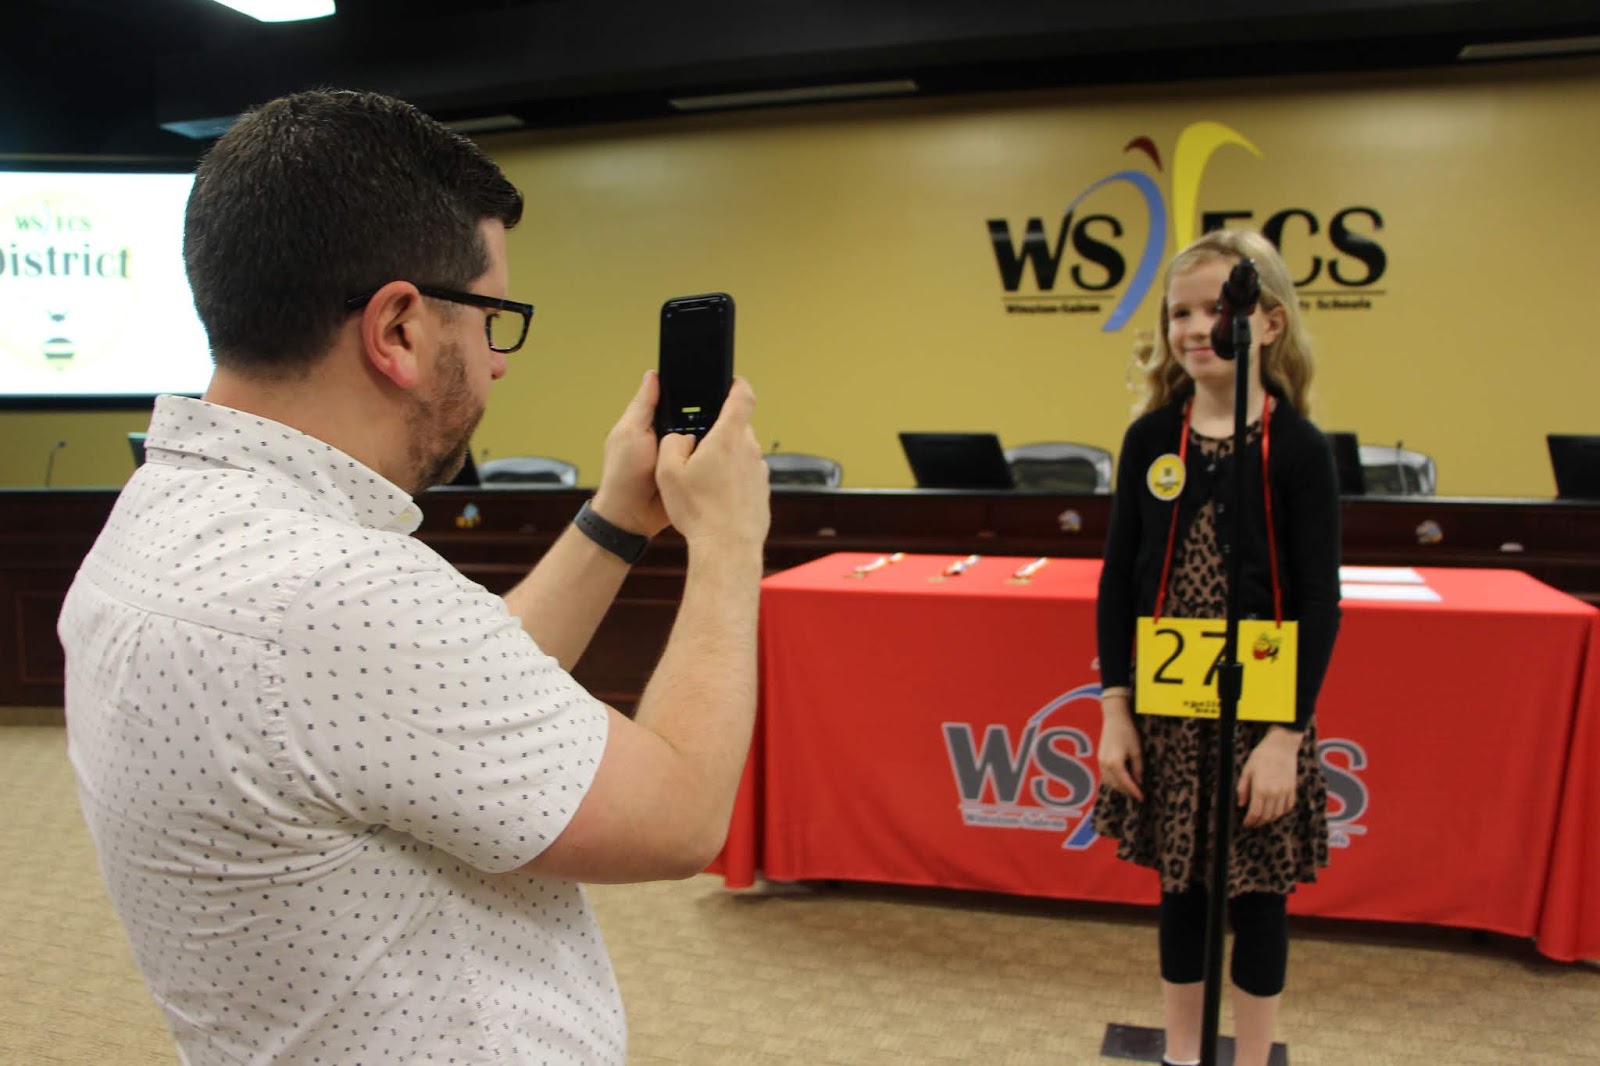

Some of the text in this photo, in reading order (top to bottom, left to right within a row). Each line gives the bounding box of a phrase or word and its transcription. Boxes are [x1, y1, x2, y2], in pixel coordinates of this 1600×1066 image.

[986, 209, 1126, 292] WS
[1152, 628, 1227, 686] 27
[942, 722, 1093, 807] WS
